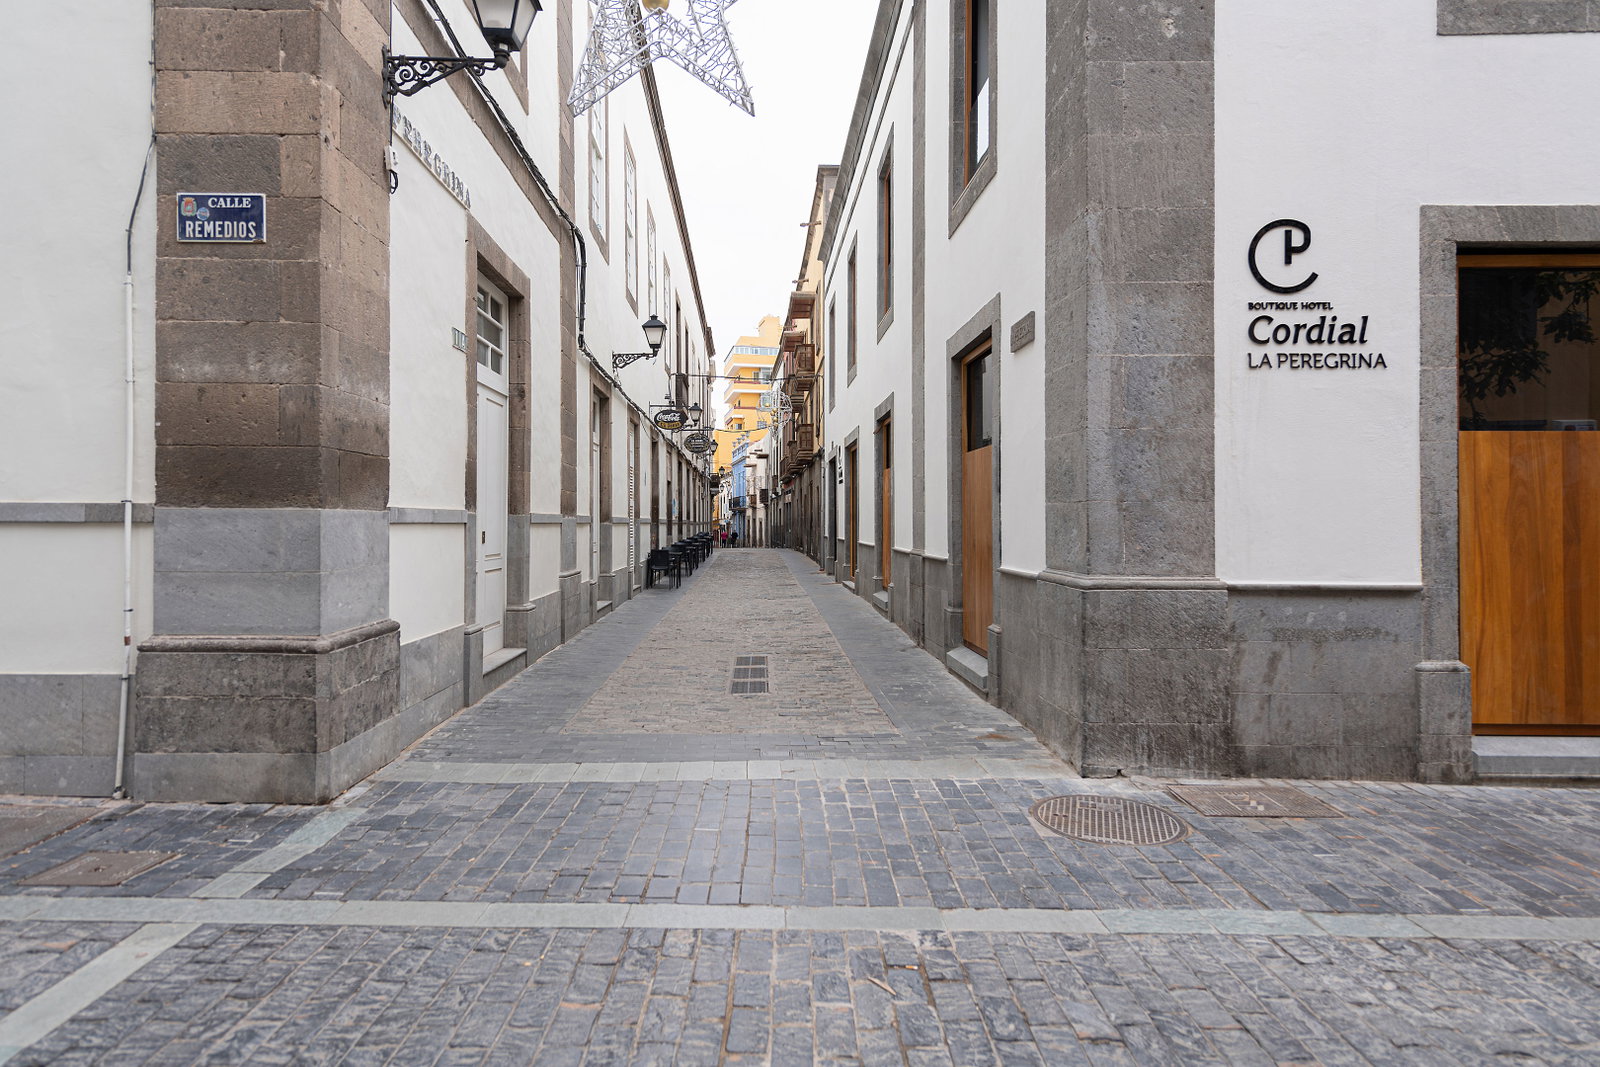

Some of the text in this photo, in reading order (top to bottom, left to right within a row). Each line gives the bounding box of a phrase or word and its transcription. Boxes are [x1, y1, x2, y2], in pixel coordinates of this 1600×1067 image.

[208, 197, 252, 209] CALLE
[185, 220, 257, 238] REMEDIOS
[1248, 302, 1334, 311] BOUTIQUE HOTEL
[1248, 315, 1369, 345] Cordial
[1248, 353, 1388, 369] LA PEREGRINA
